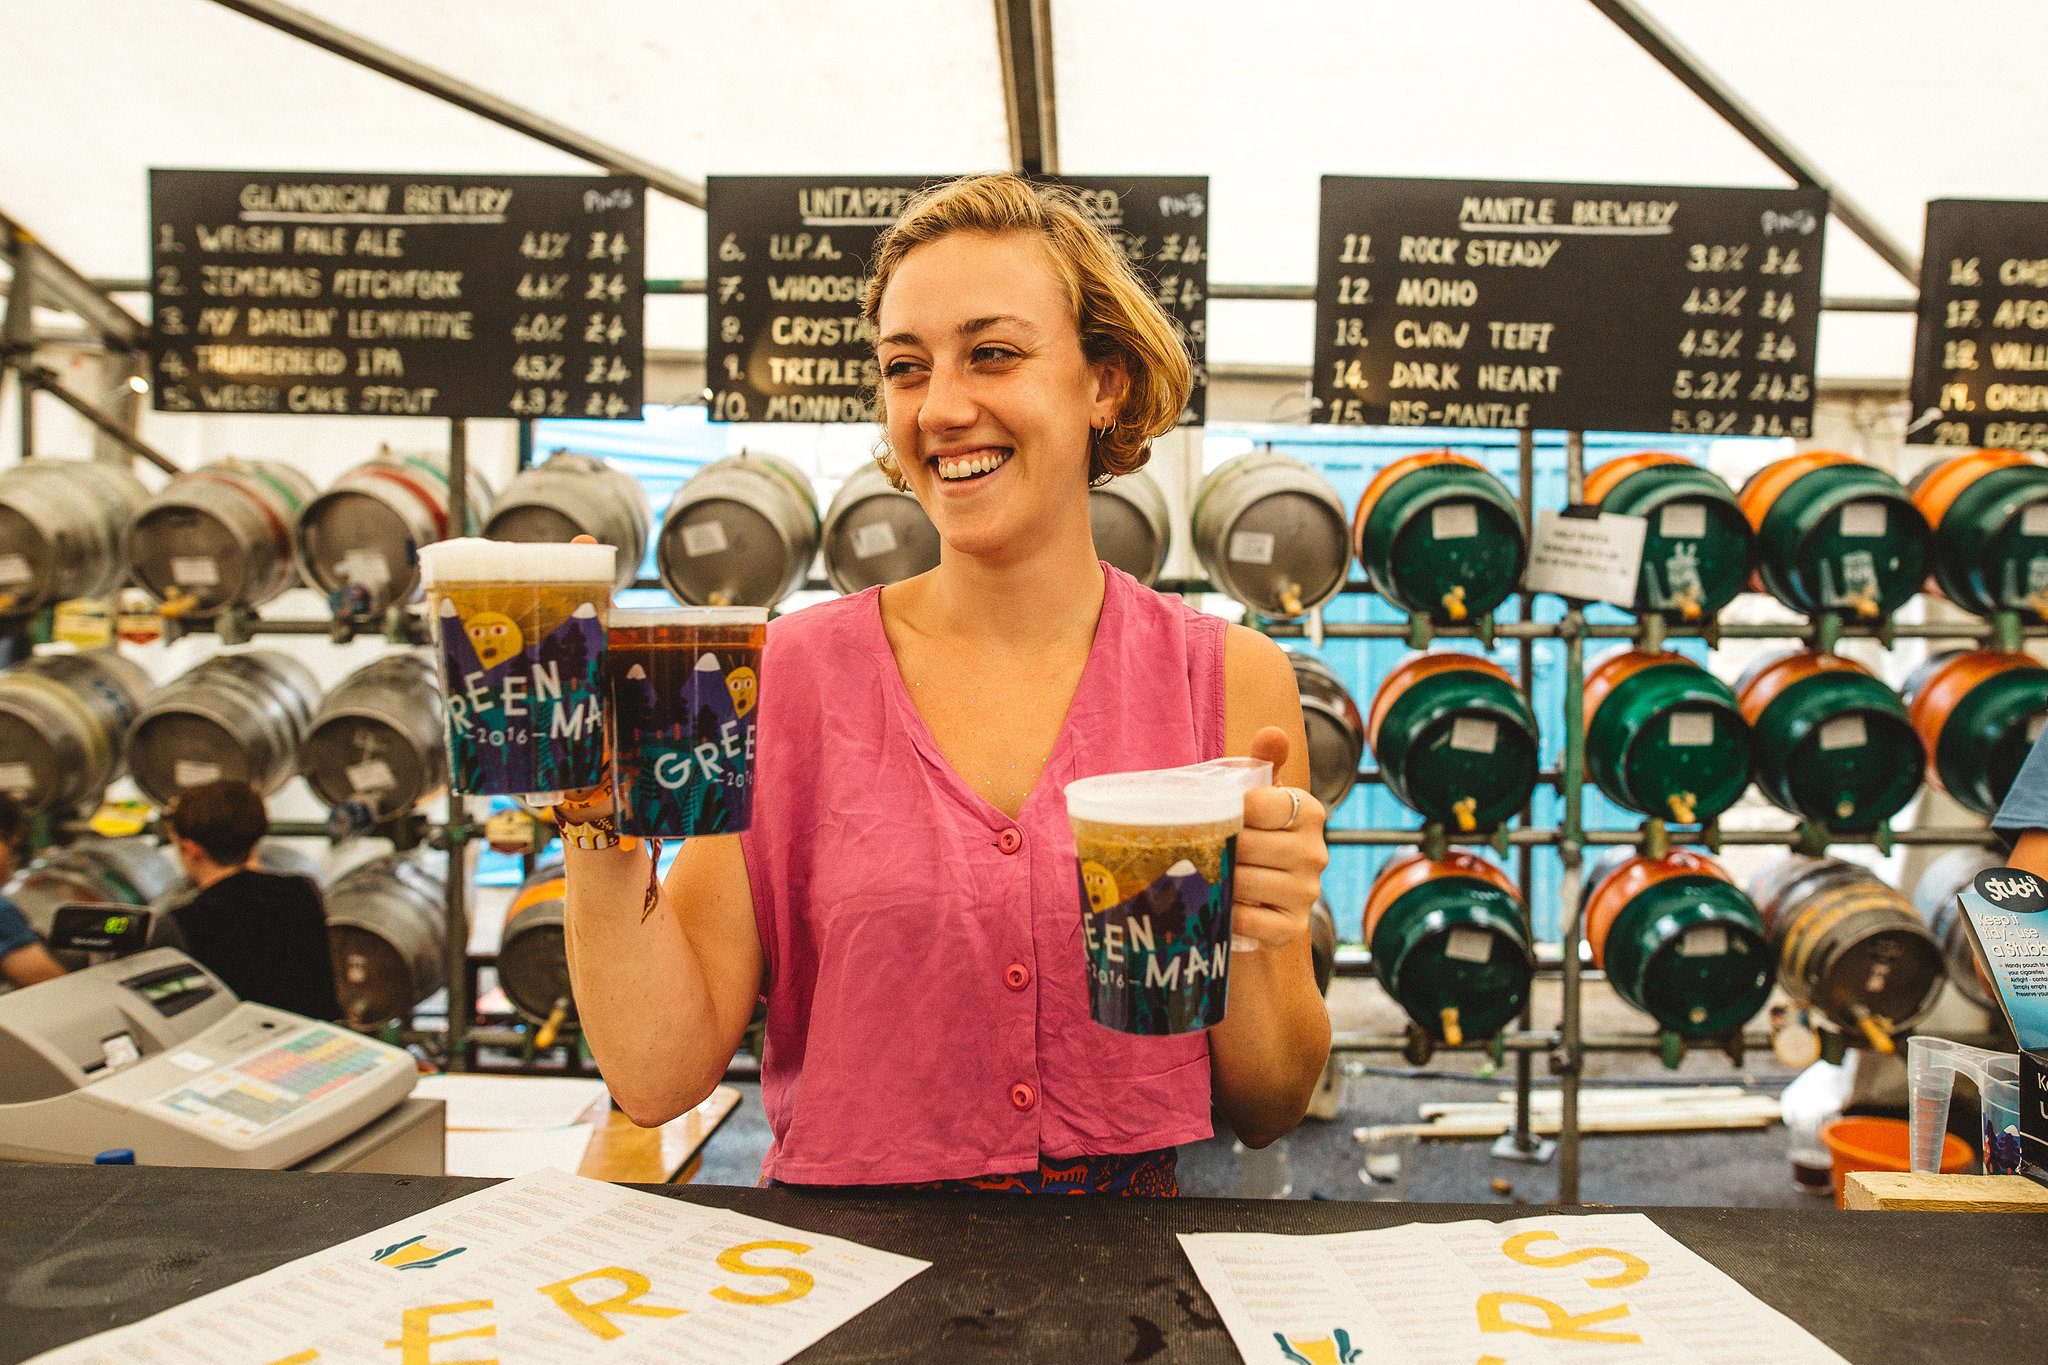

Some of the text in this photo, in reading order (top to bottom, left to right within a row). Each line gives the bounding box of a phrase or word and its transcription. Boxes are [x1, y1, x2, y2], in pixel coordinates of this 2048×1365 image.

[403, 184, 513, 213] BREWERY
[799, 187, 908, 217] UNTAPPE
[1458, 196, 1680, 226] MANTLE BREWERY
[196, 223, 284, 254] WELSH
[293, 225, 348, 255] PALE
[354, 227, 406, 257] ALE
[719, 232, 747, 262] 6.
[1398, 235, 1461, 265] ROCK
[1465, 238, 1562, 269] STEADY
[718, 274, 746, 304] 7.
[1396, 277, 1478, 307] MOHO
[721, 315, 744, 343] 8.
[1394, 318, 1471, 350] CWRW
[1388, 360, 1461, 391] DARK
[1477, 364, 1562, 393] HEART
[1672, 369, 1742, 399] 5.2%
[1388, 400, 1531, 427] DIS-MANTLE
[1977, 913, 2020, 927] Keep it
[1983, 927, 2007, 941] tidy
[2016, 928, 2039, 938] use
[1992, 944, 2005, 957] a
[1146, 941, 1227, 991] MAN
